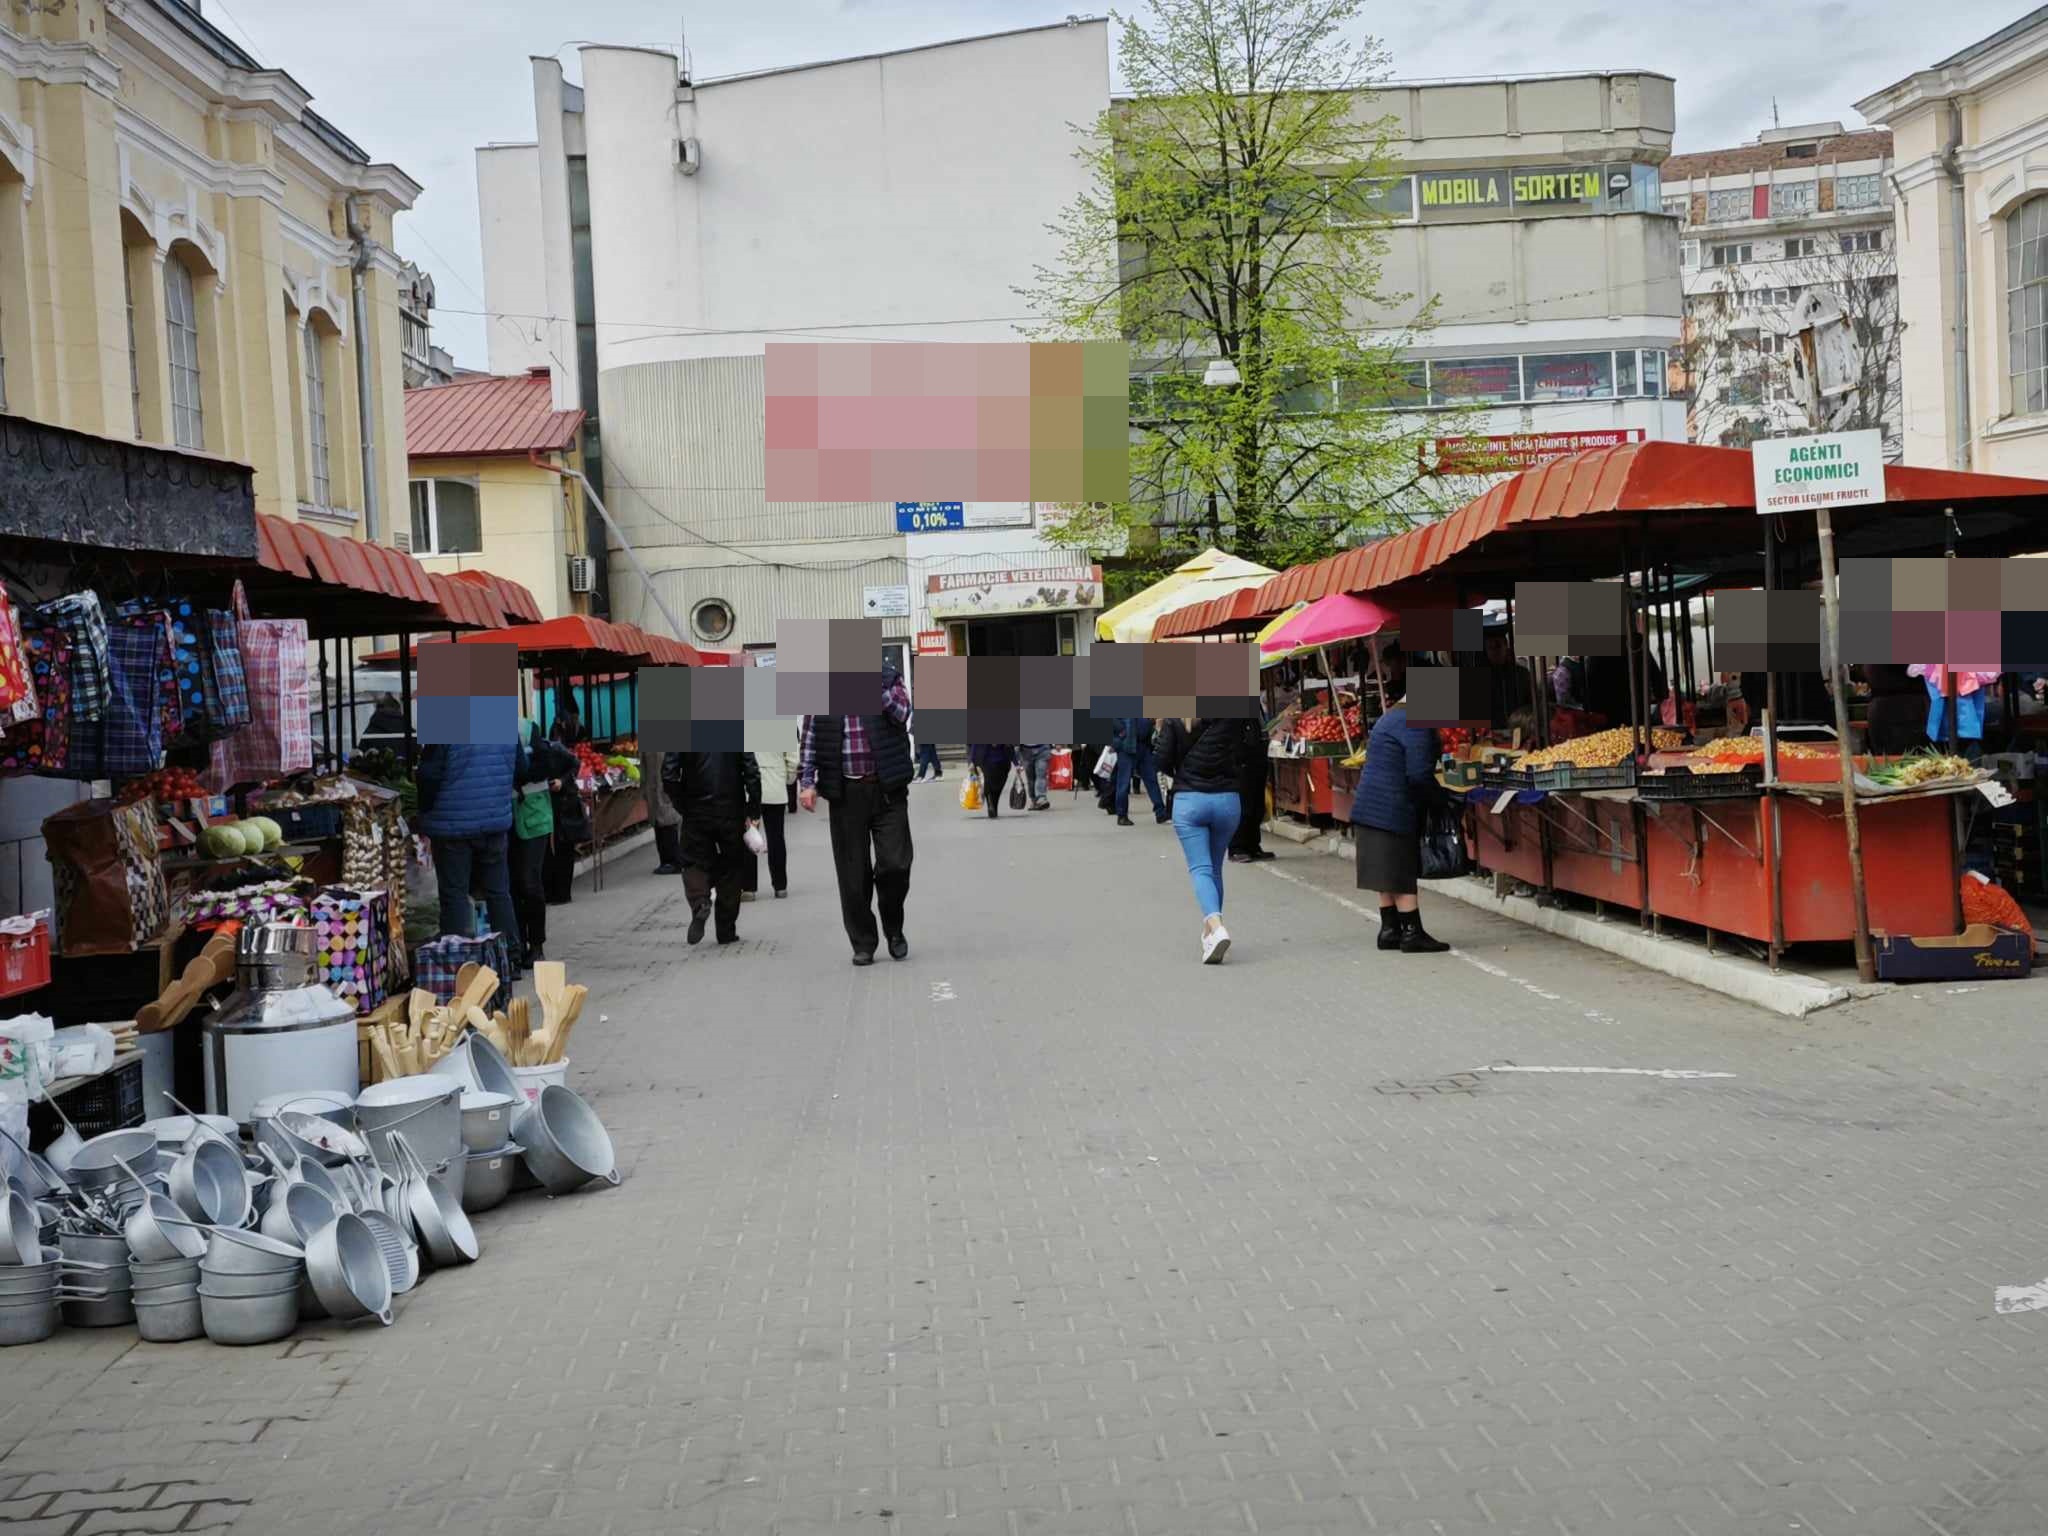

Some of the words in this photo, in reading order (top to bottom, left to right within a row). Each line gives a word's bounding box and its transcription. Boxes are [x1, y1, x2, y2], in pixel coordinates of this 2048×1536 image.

[1422, 177, 1499, 205] MOBILA
[1514, 172, 1600, 201] SORTEM
[1580, 434, 1618, 446] PRODUSE
[1790, 444, 1842, 462] AGENTI
[1775, 462, 1859, 483] ECONOMICI
[1767, 495, 1800, 506] SECTOR
[1802, 491, 1834, 504] LEGUME
[1837, 489, 1869, 500] FRUCTE
[912, 512, 948, 530] 0,10%
[939, 571, 1008, 590] FARMACIE
